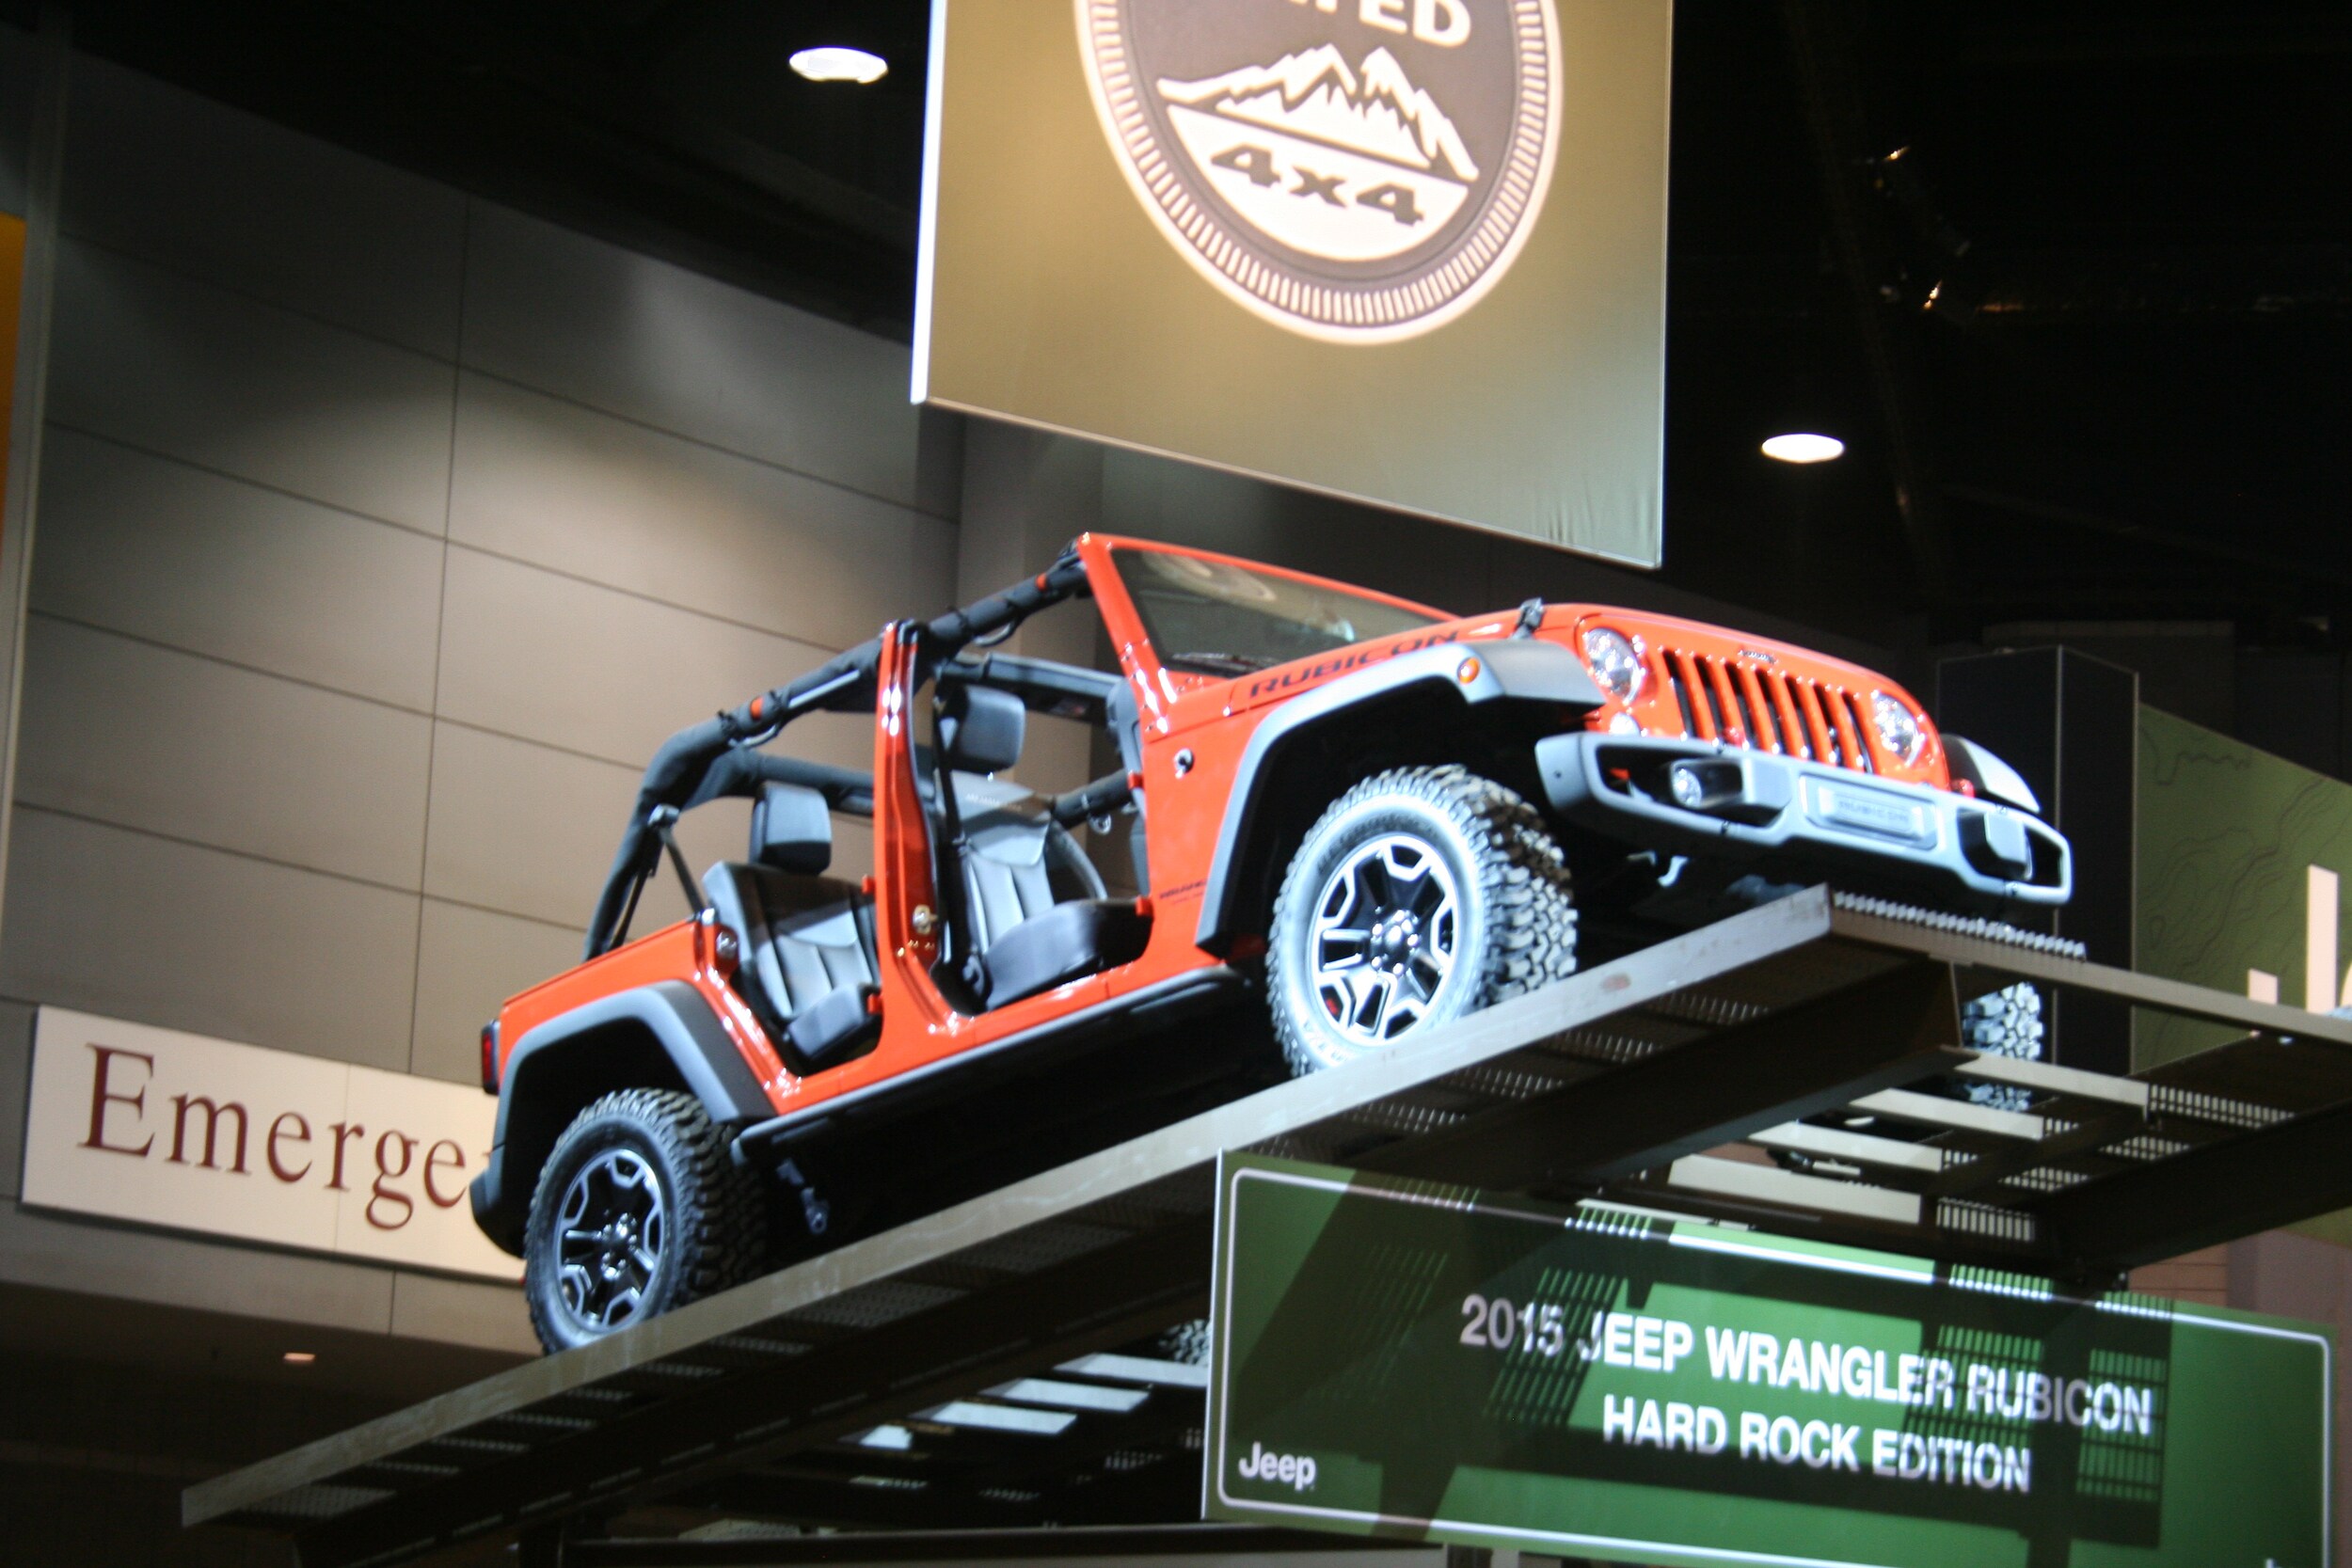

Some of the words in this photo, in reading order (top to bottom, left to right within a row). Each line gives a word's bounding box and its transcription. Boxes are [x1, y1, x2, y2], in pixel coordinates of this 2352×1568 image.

[1249, 632, 1457, 698] RUBICON
[77, 1043, 491, 1230] Emerge
[1460, 1293, 1565, 1357] 2015
[1577, 1310, 1694, 1372] JEEP
[1705, 1325, 1956, 1410] WRANGLER
[1966, 1363, 2153, 1436] RUBICON
[1238, 1441, 1316, 1491] Jeep
[1603, 1394, 1727, 1455] HARD
[1740, 1411, 1861, 1472] ROCK
[1872, 1428, 2031, 1494] EDITION
